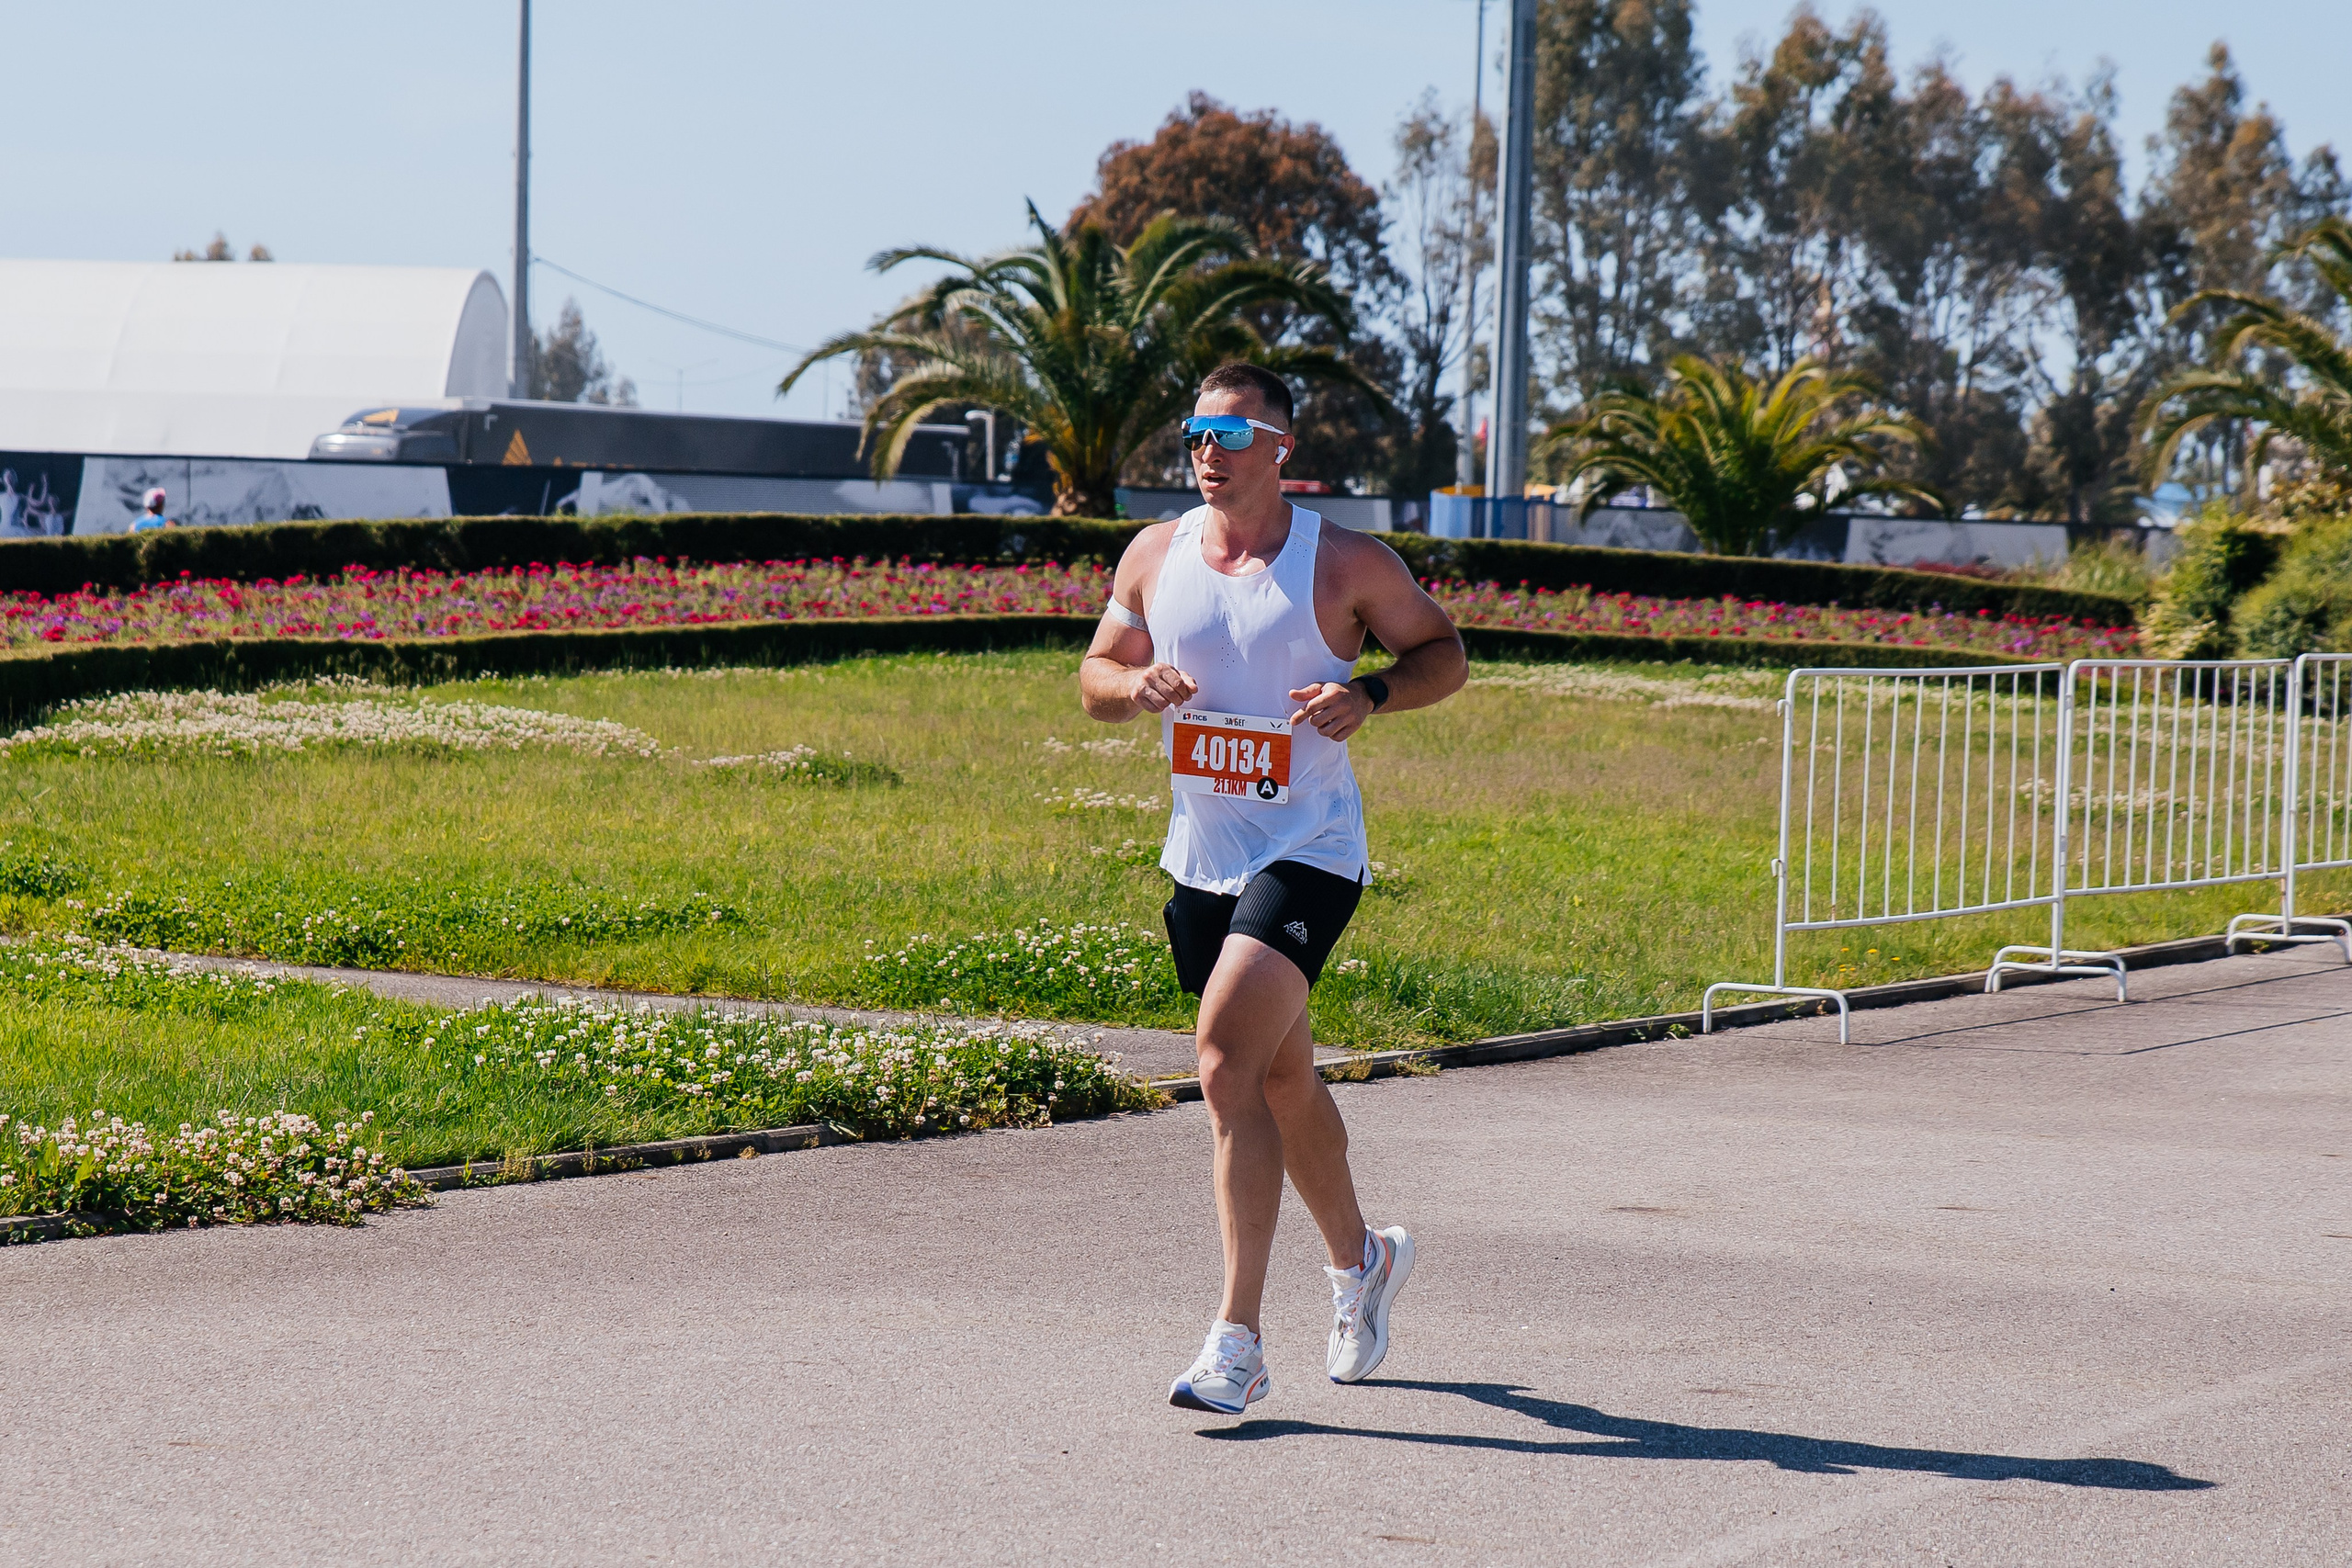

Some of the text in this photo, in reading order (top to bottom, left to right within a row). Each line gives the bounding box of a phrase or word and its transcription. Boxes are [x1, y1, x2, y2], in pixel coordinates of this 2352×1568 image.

[1193, 714, 1207, 722] ПСБ
[1191, 734, 1272, 776] 40134
[1214, 778, 1248, 796] 21.1KM
[1260, 780, 1274, 795] A
